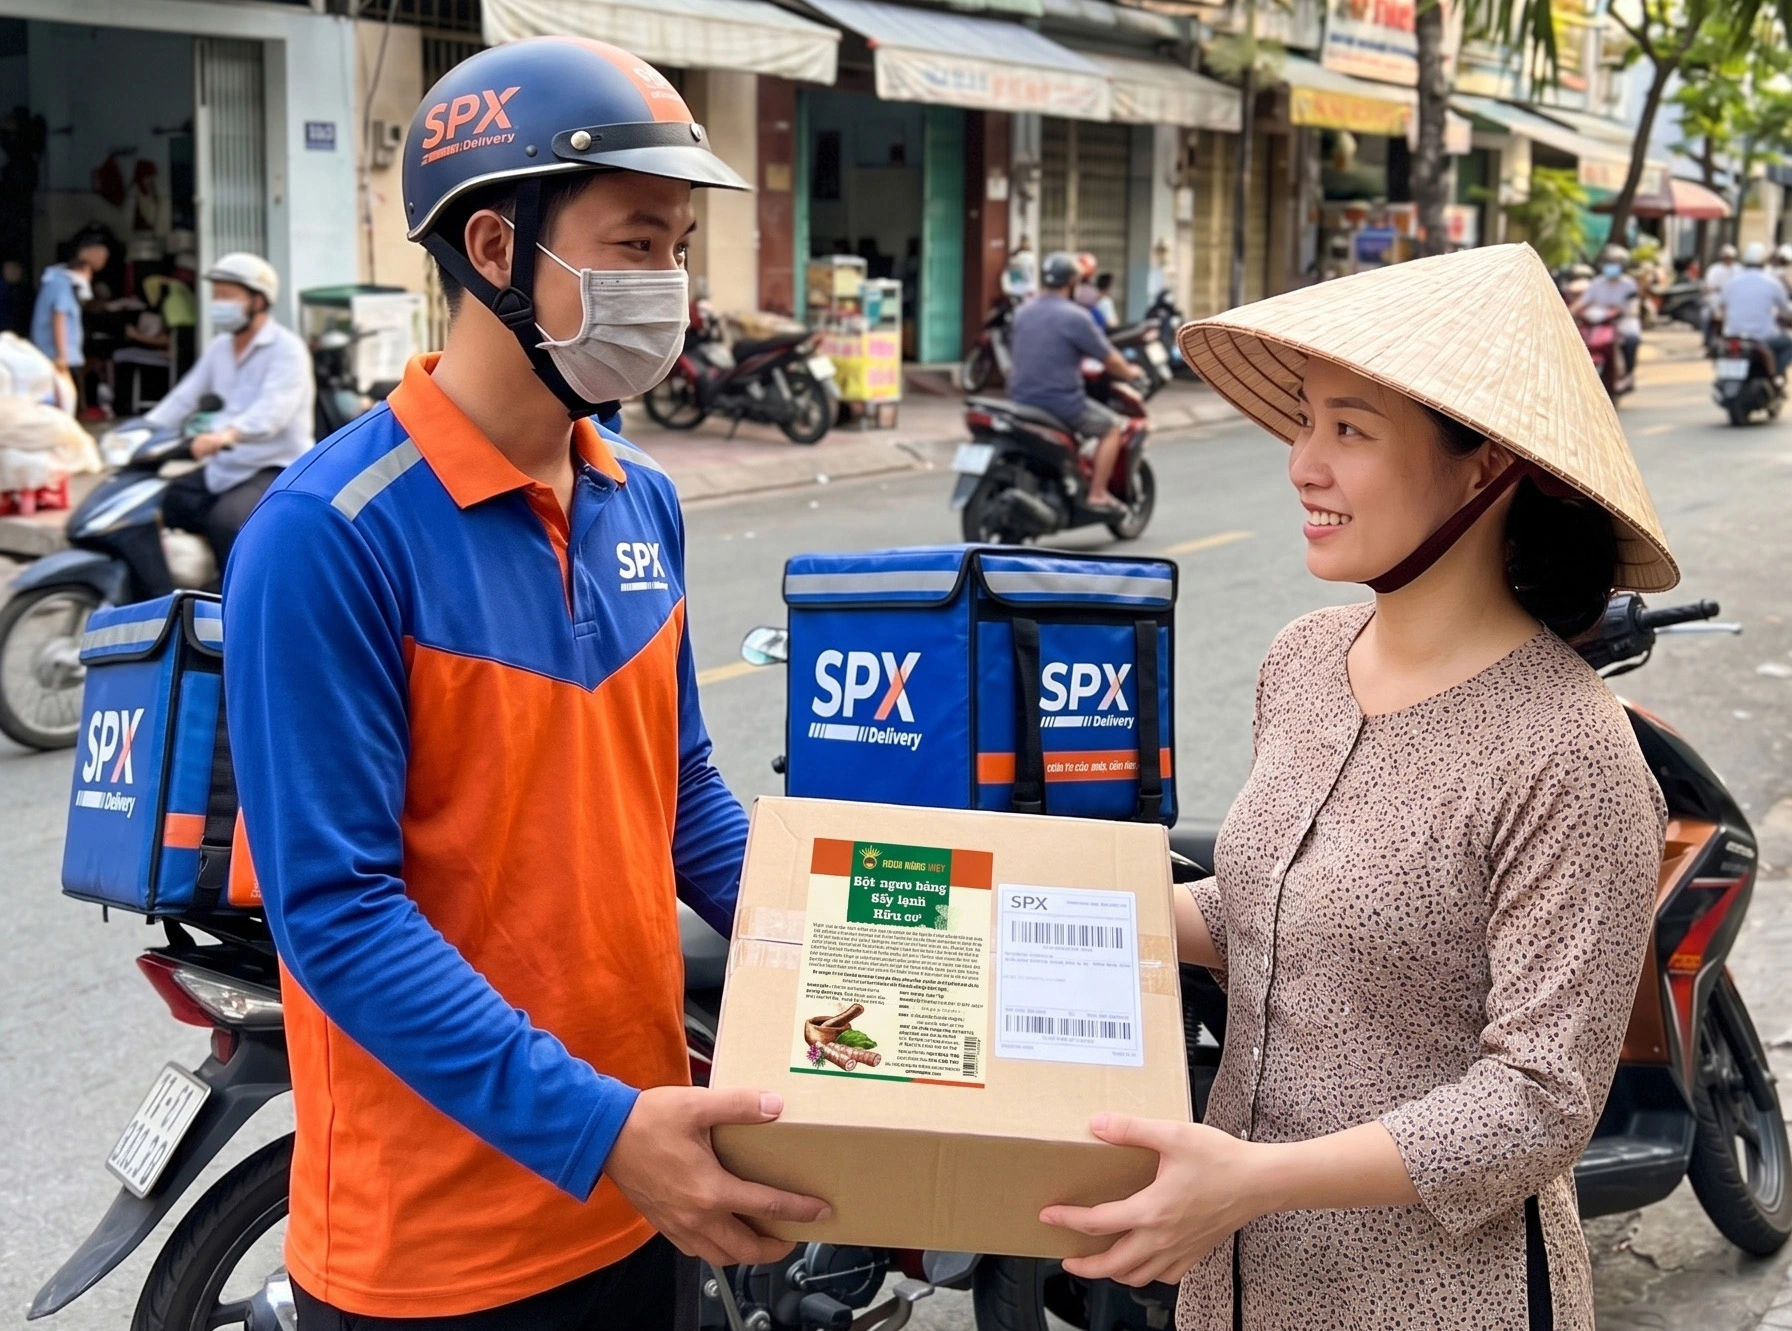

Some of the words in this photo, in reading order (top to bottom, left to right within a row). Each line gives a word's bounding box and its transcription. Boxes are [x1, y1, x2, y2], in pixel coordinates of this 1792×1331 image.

[422, 86, 521, 150] SPX
[616, 542, 666, 579] SPX
[811, 649, 922, 723] SPX
[1038, 661, 1132, 712] SPX
[867, 726, 922, 751] Delivery
[1092, 714, 1135, 730] Delivery
[82, 708, 145, 784] SPX
[1011, 895, 1048, 911] SPX
